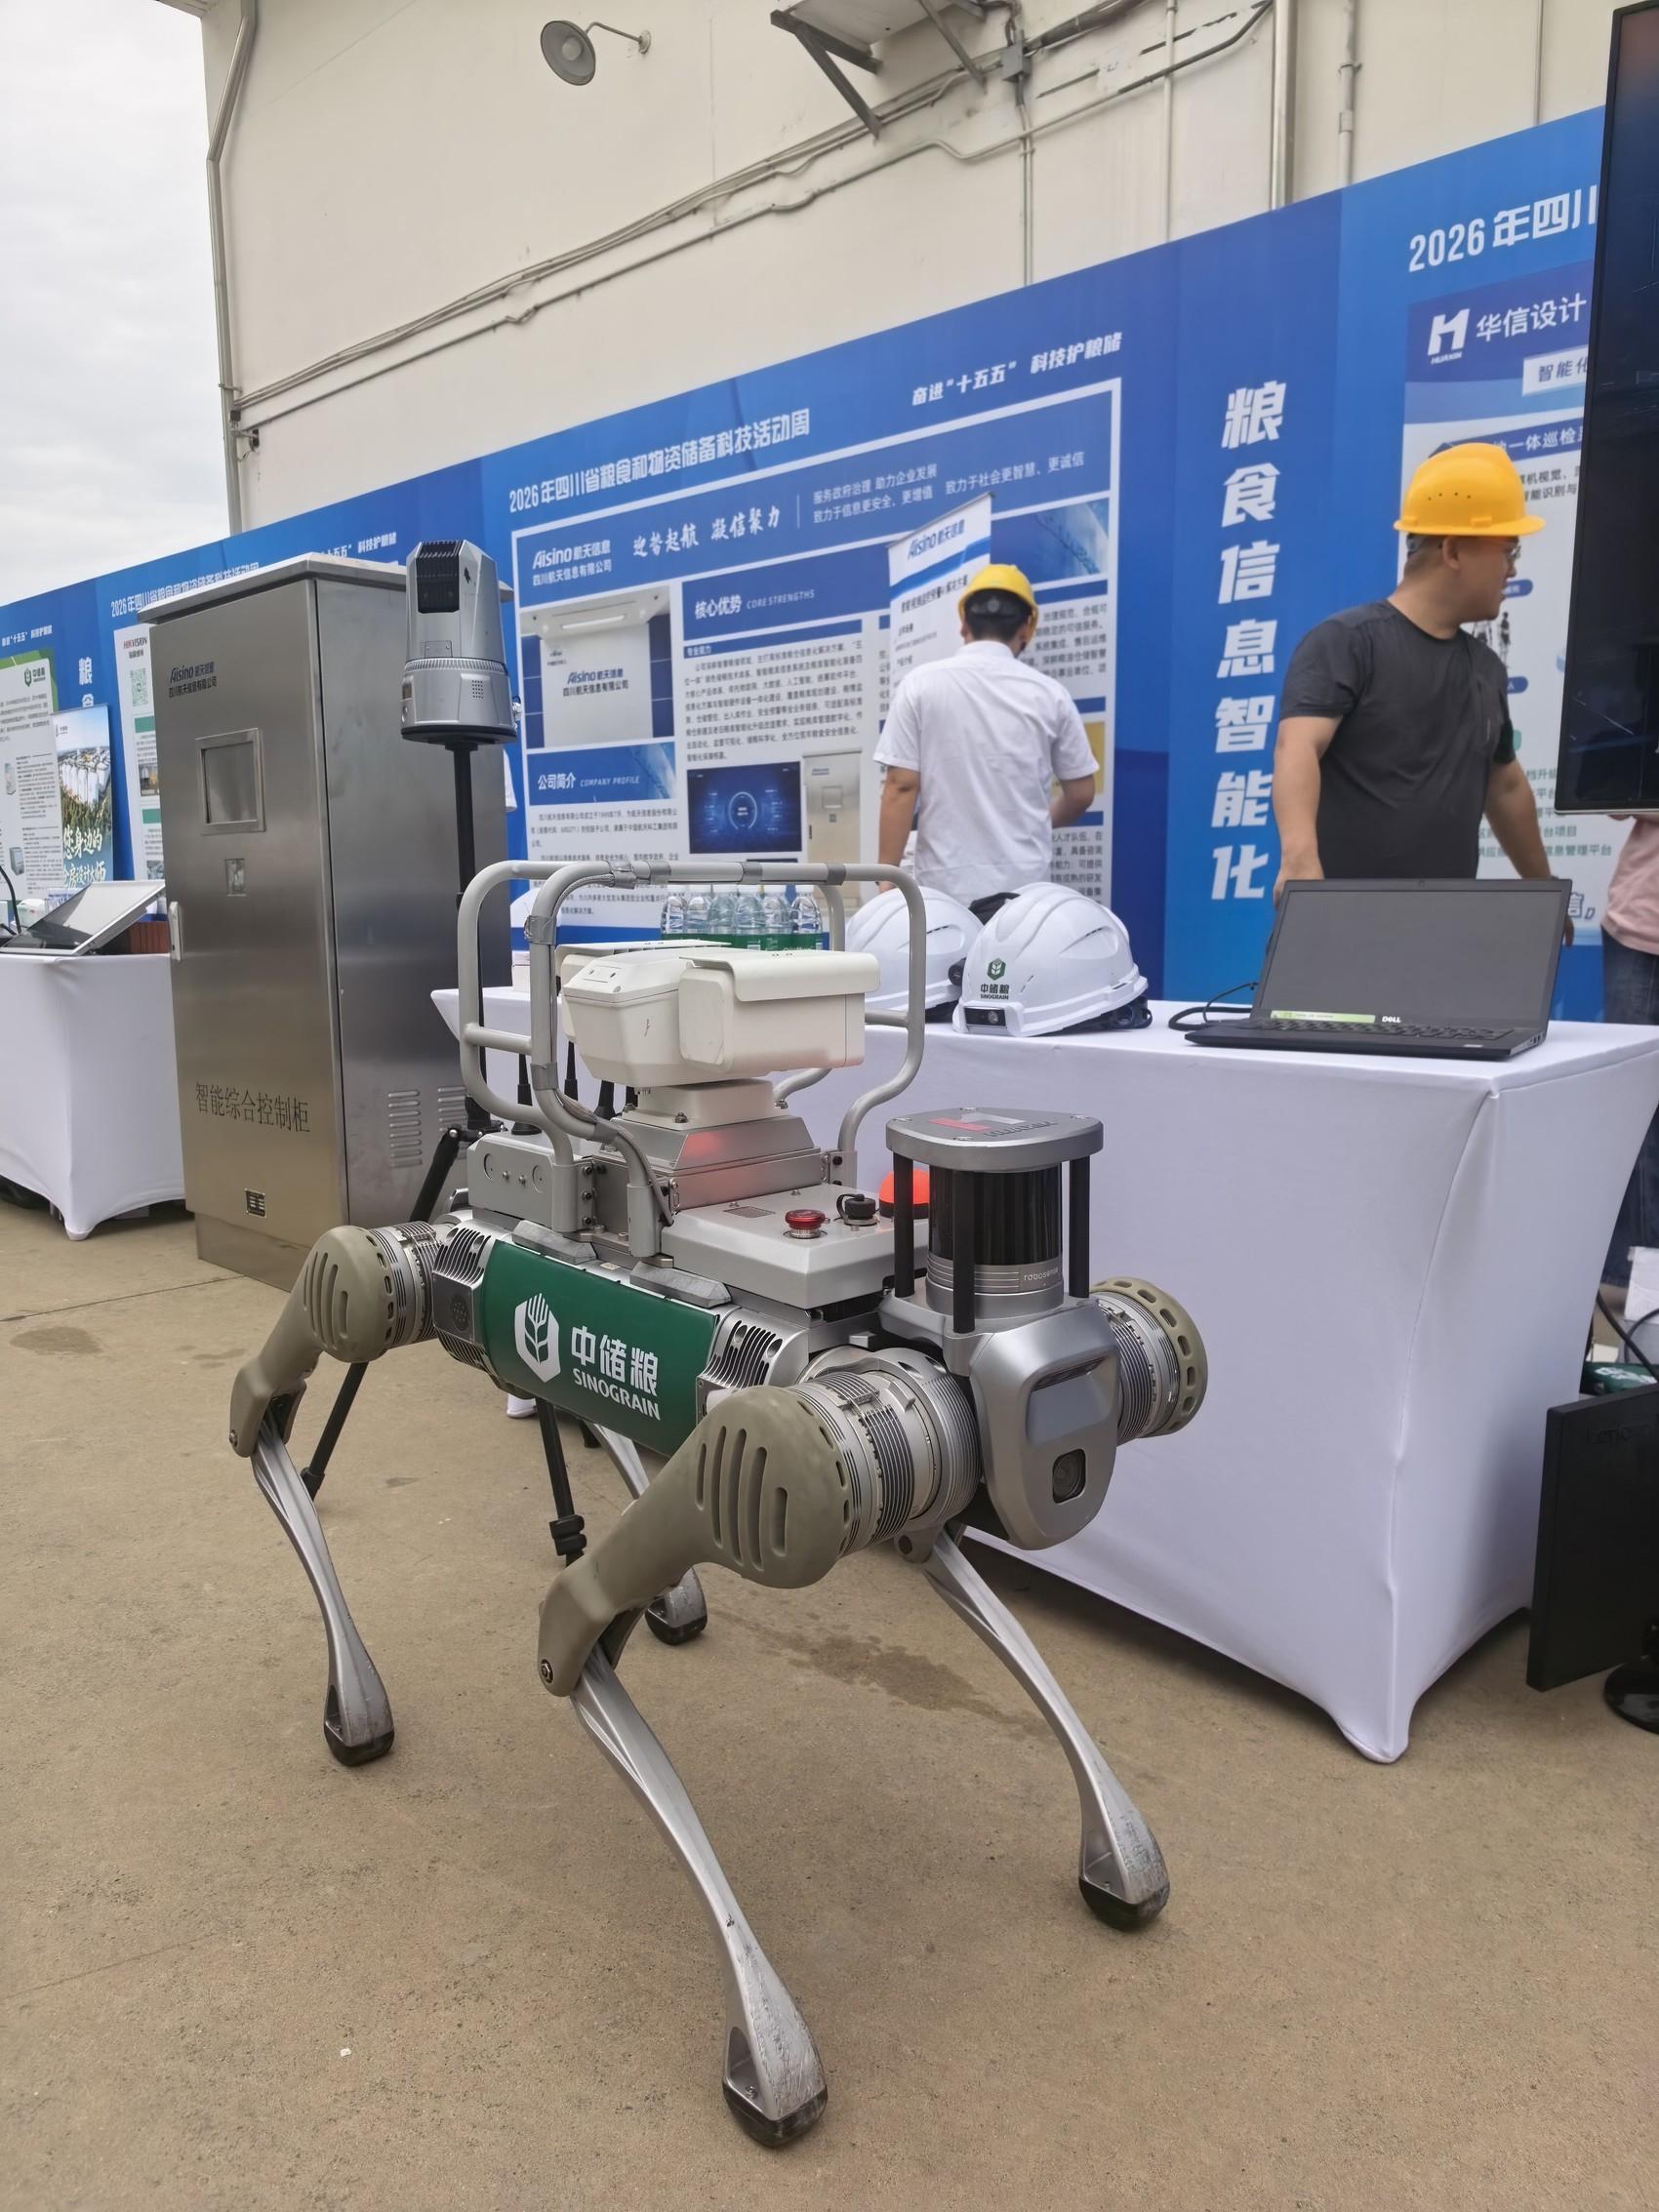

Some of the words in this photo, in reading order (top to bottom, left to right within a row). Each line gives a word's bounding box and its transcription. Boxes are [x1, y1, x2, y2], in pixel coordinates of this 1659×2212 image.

[1476, 293, 1588, 342] 华信设计
[1030, 332, 1122, 374] 科技护粮储
[508, 407, 810, 513] 2026年四川省粮食和物资储备科技活动周
[812, 478, 871, 504] 服务政府治理
[874, 463, 938, 490] 助力企业发展
[532, 545, 572, 570] Aisino
[573, 539, 611, 561] 航天信息
[532, 558, 612, 586] 四川航天信息有限公司
[694, 594, 743, 621] 核心优势
[1211, 380, 1287, 901] 粮食信息智能化
[170, 665, 194, 684] Aisino
[538, 772, 577, 790] 公司简介
[980, 983, 1010, 994] 中储粮
[195, 1081, 311, 1133] 智能综合控制柜
[1023, 1267, 1059, 1282] robosense
[570, 1325, 659, 1397] 中储粮
[572, 1367, 661, 1421] SINOGRAIN
